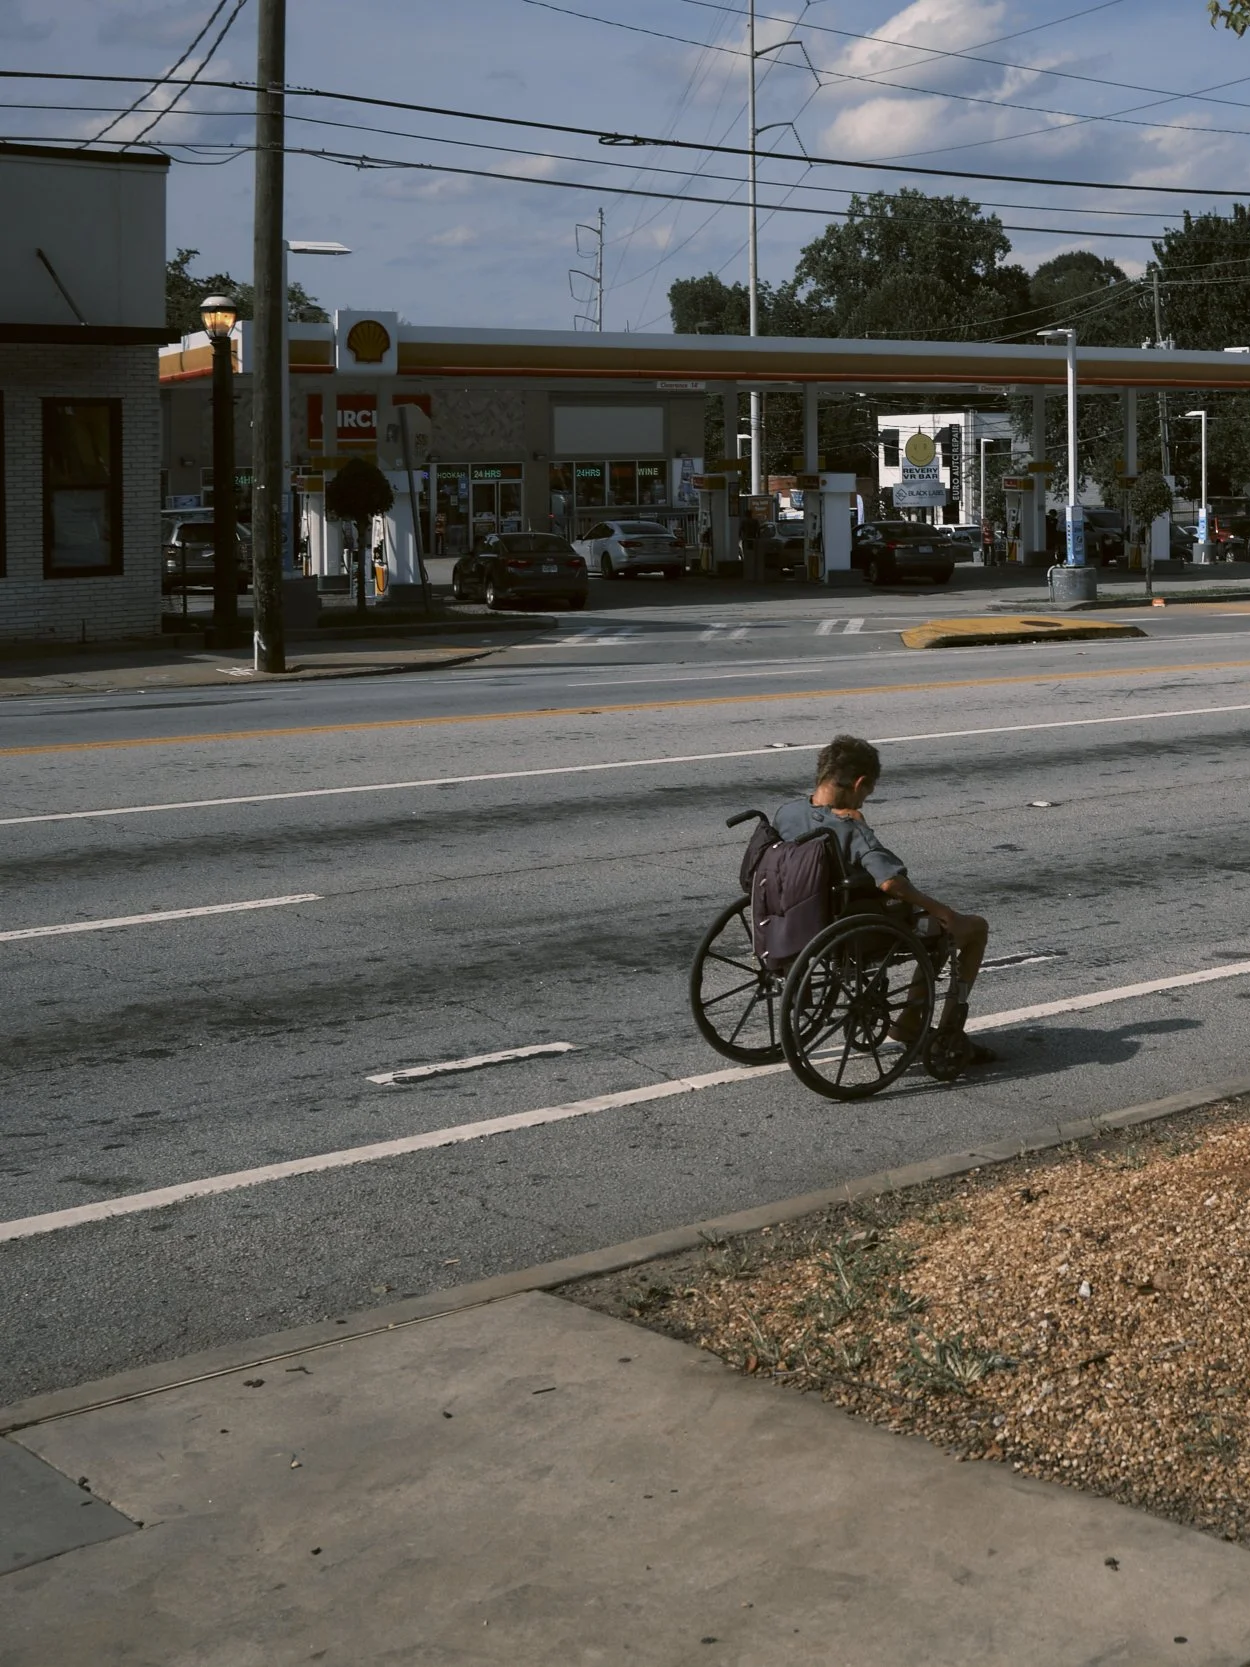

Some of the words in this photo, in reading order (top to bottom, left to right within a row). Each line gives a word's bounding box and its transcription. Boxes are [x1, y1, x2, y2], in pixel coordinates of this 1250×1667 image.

[485, 470, 502, 478] HRS
[576, 469, 601, 477] 24HRS
[952, 478, 960, 501] EURO
